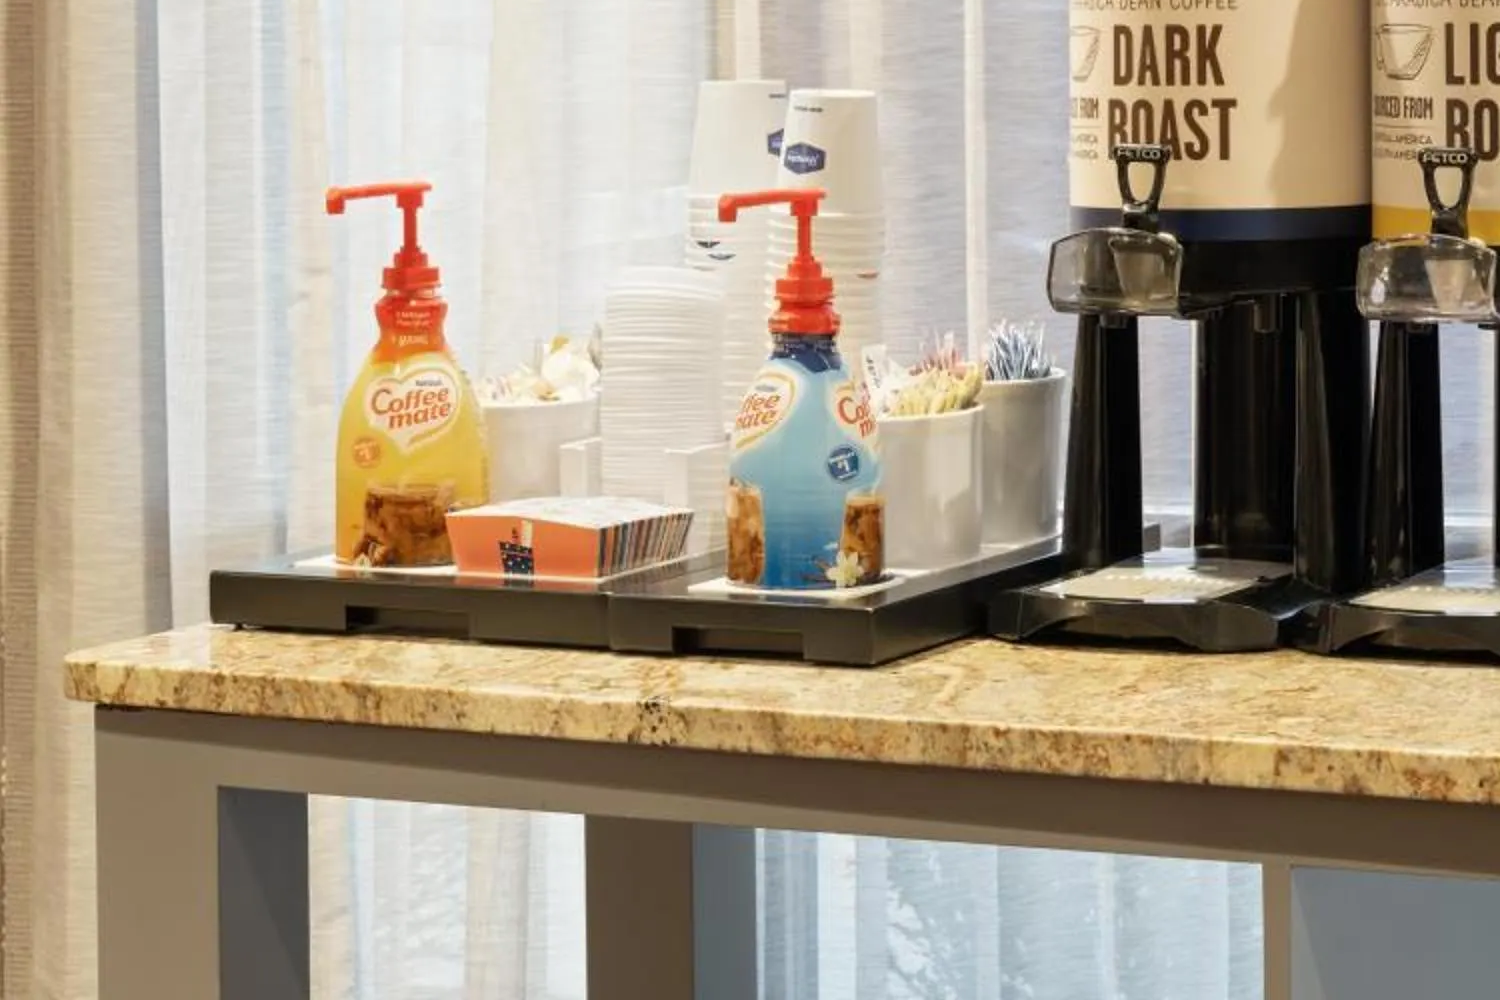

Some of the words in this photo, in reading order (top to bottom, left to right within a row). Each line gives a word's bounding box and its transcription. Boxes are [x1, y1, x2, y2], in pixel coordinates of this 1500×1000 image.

[1113, 24, 1226, 87] DARK
[1108, 98, 1238, 161] ROAST
[371, 388, 449, 415] Coffee
[388, 403, 451, 429] mate
